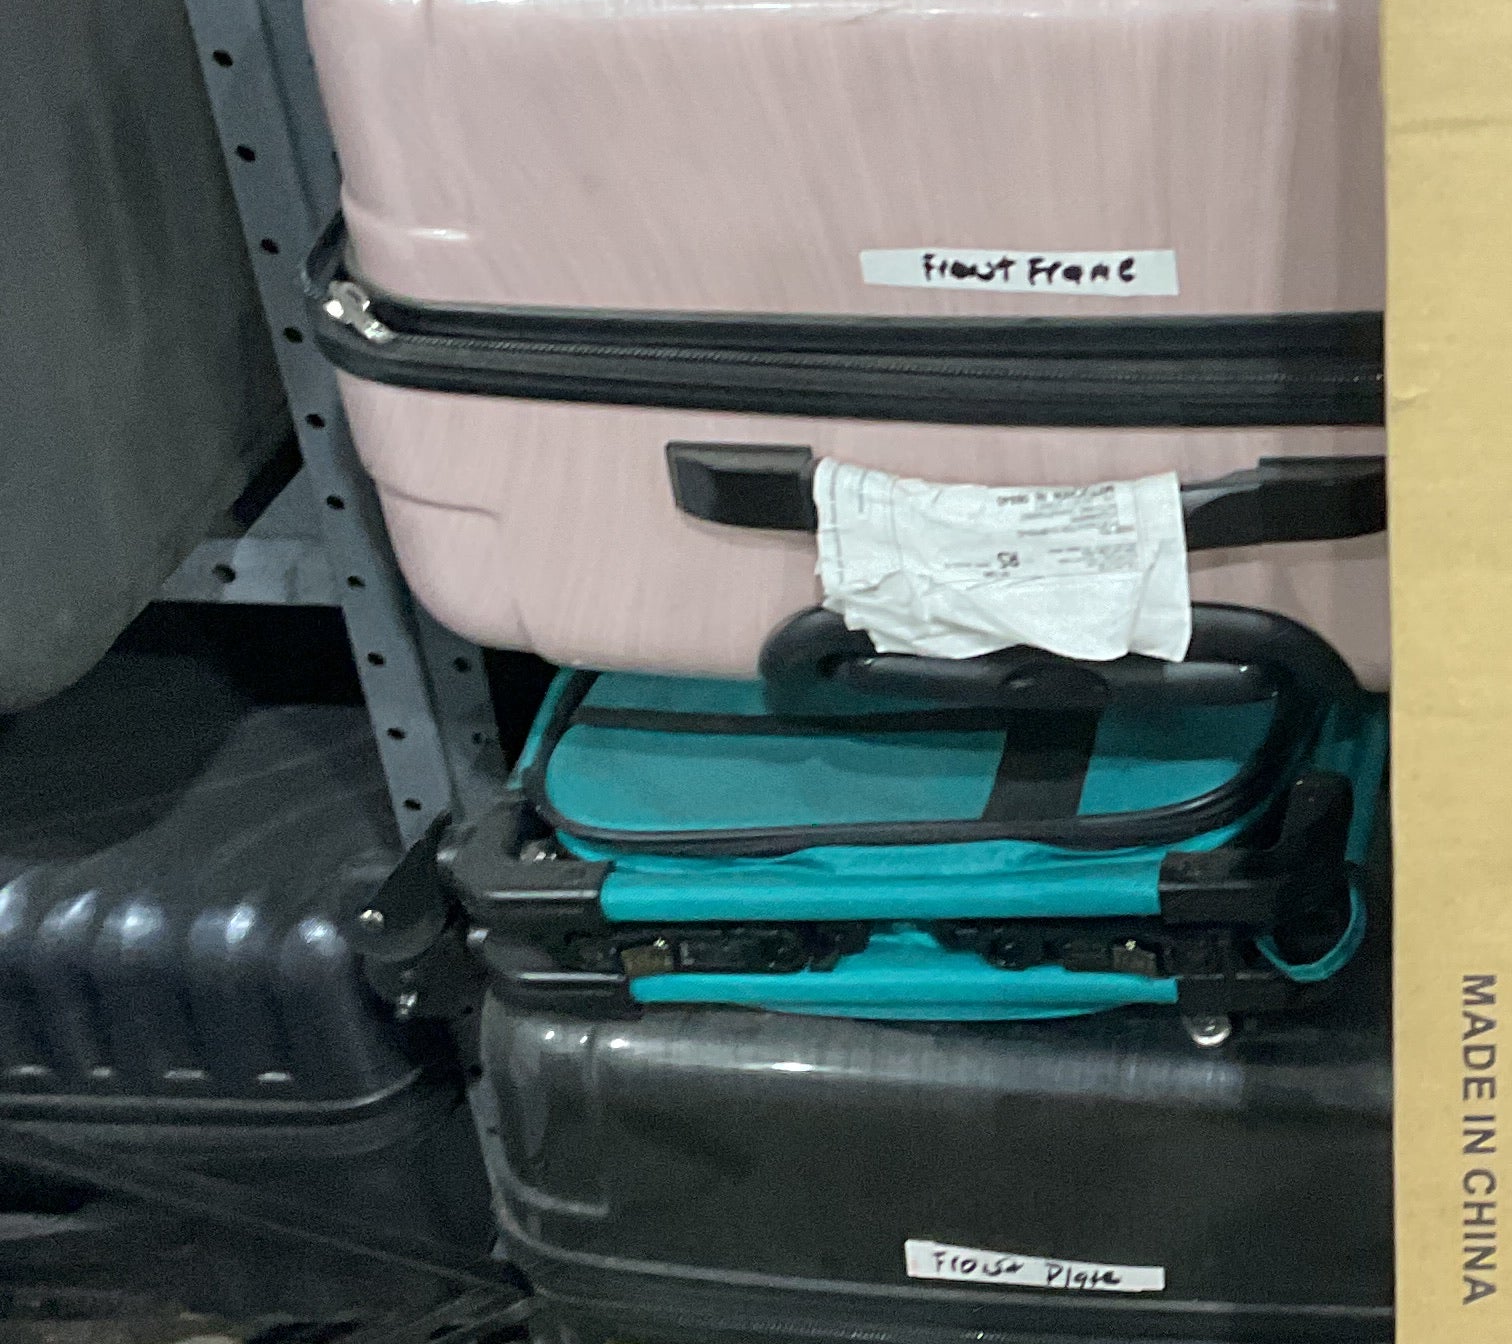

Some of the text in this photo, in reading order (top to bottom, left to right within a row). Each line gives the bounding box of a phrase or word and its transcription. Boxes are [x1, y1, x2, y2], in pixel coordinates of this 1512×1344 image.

[1461, 974, 1496, 1305] MADE IN CHINA
